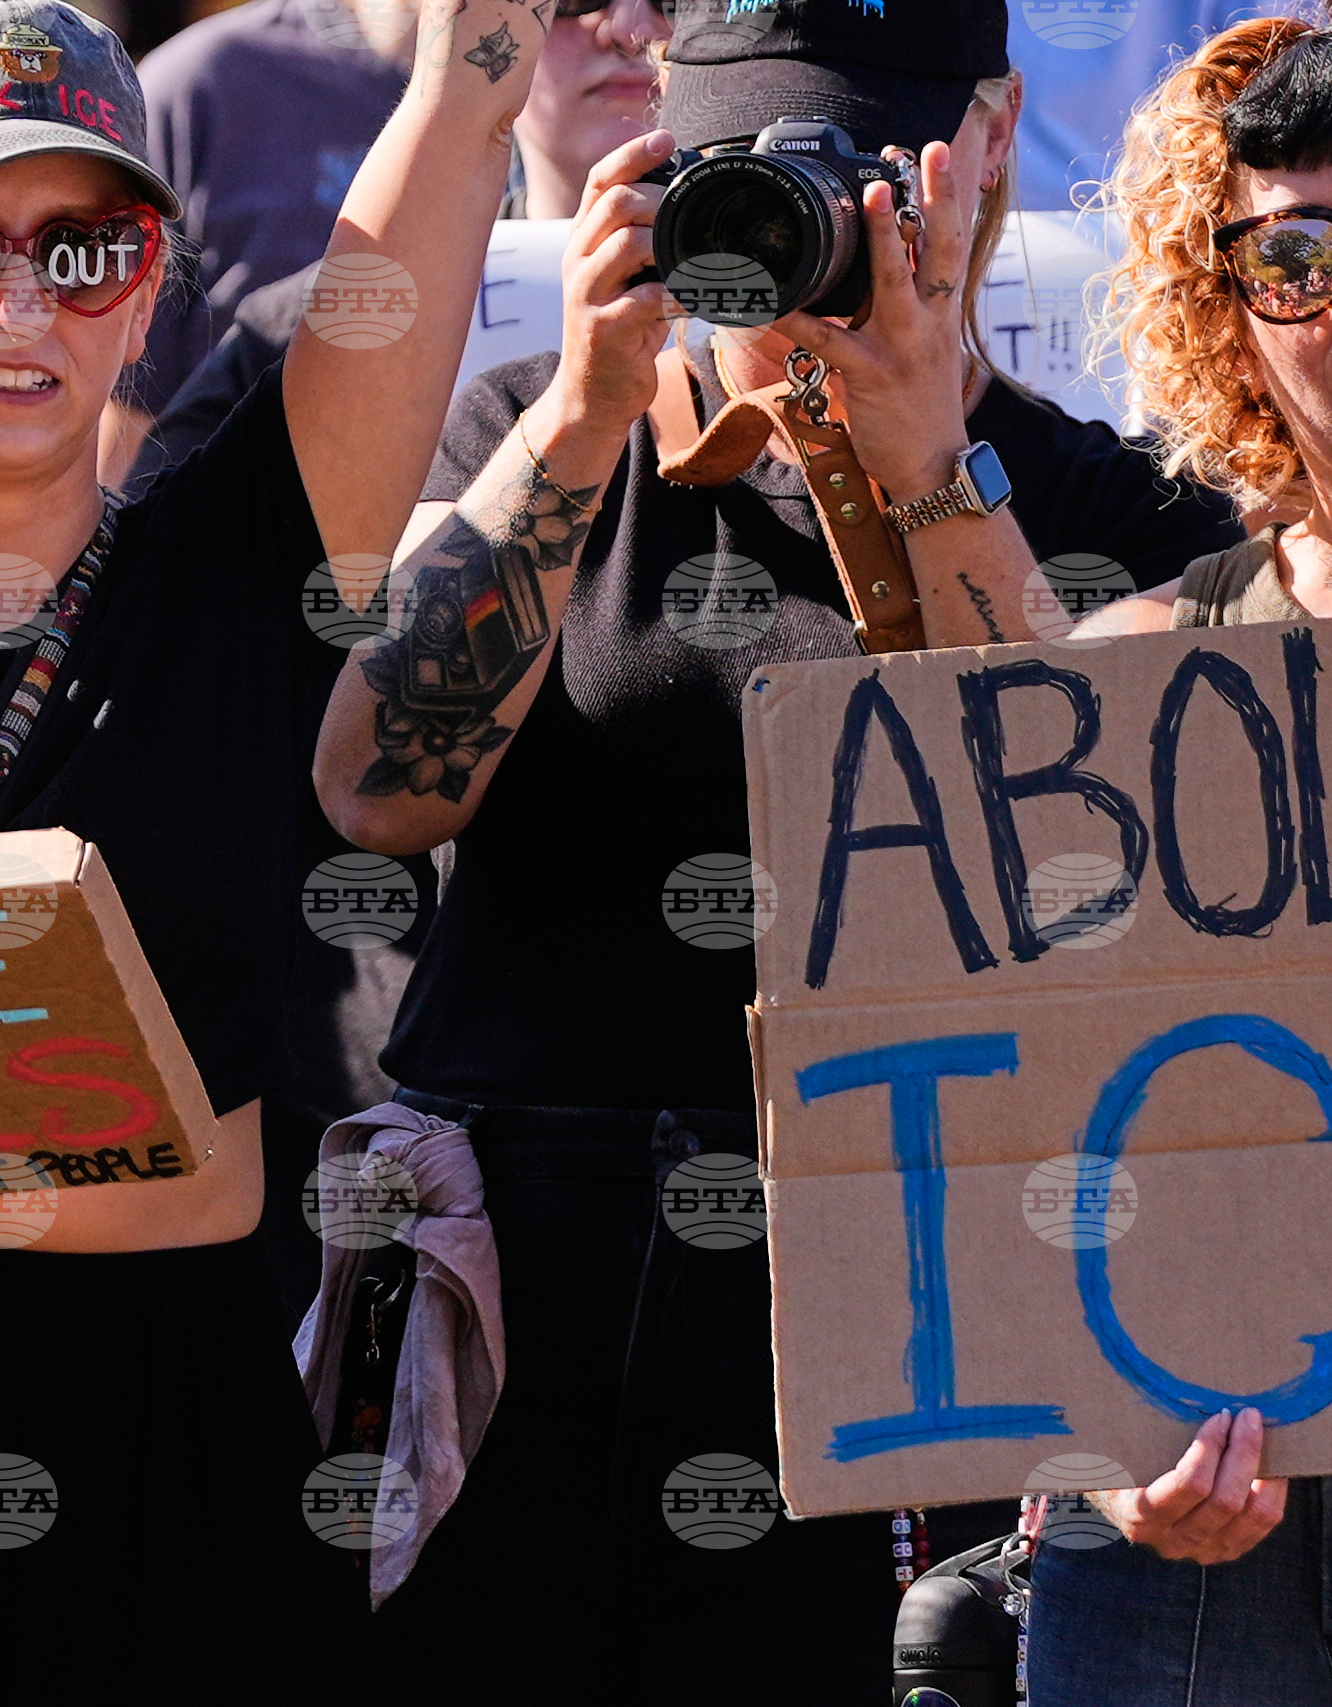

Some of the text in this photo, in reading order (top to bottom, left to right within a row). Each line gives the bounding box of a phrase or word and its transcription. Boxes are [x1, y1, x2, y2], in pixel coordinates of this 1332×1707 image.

[769, 139, 820, 151] Canon
[858, 168, 882, 179] EOS
[48, 243, 139, 287] OUT
[28, 1141, 185, 1188] PEOPLE
